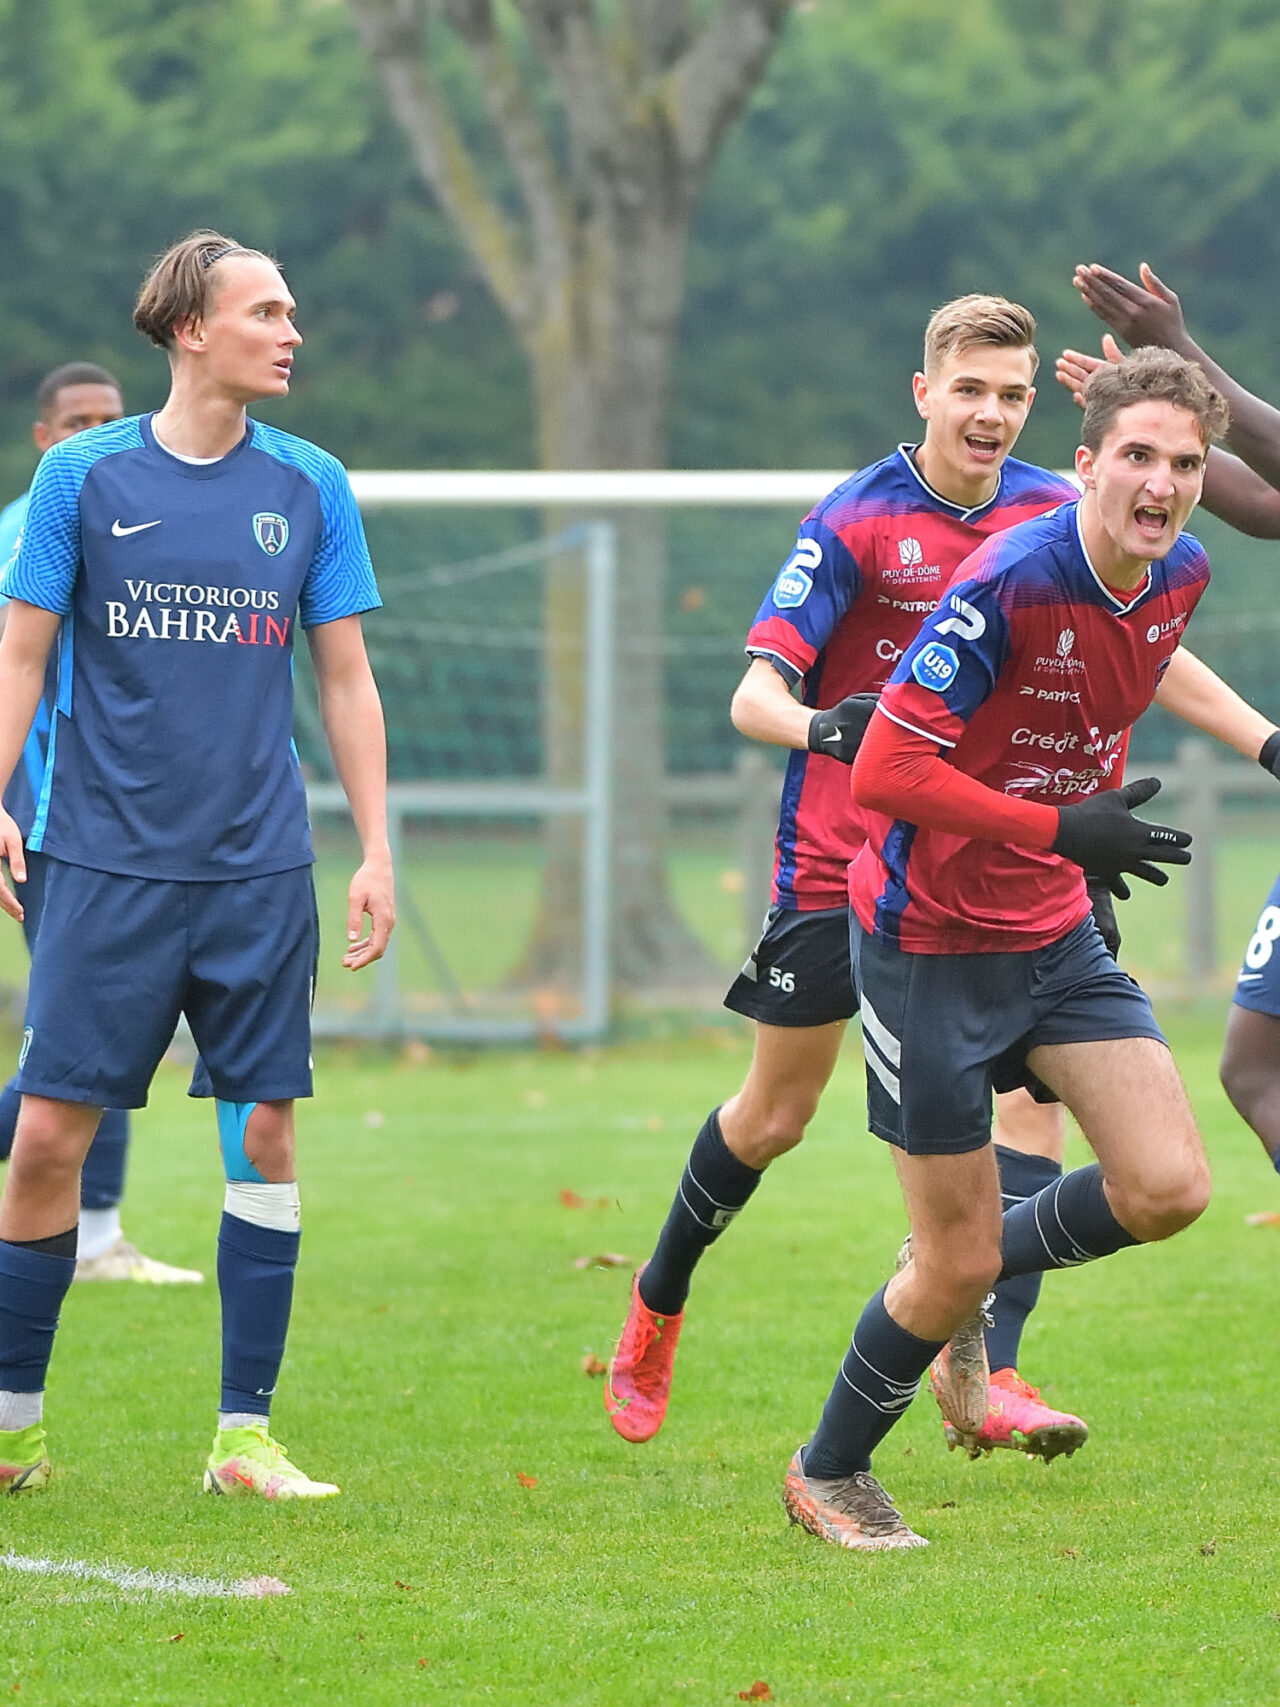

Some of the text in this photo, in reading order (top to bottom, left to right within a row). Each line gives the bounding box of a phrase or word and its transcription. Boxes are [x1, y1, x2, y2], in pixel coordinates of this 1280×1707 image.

[124, 579, 280, 611] VICTORIOUS
[892, 600, 941, 612] PATRIC
[105, 601, 291, 647] BAHRAIN
[923, 650, 953, 679] U19
[1150, 831, 1177, 843] KIPSTA
[769, 966, 796, 993] 56
